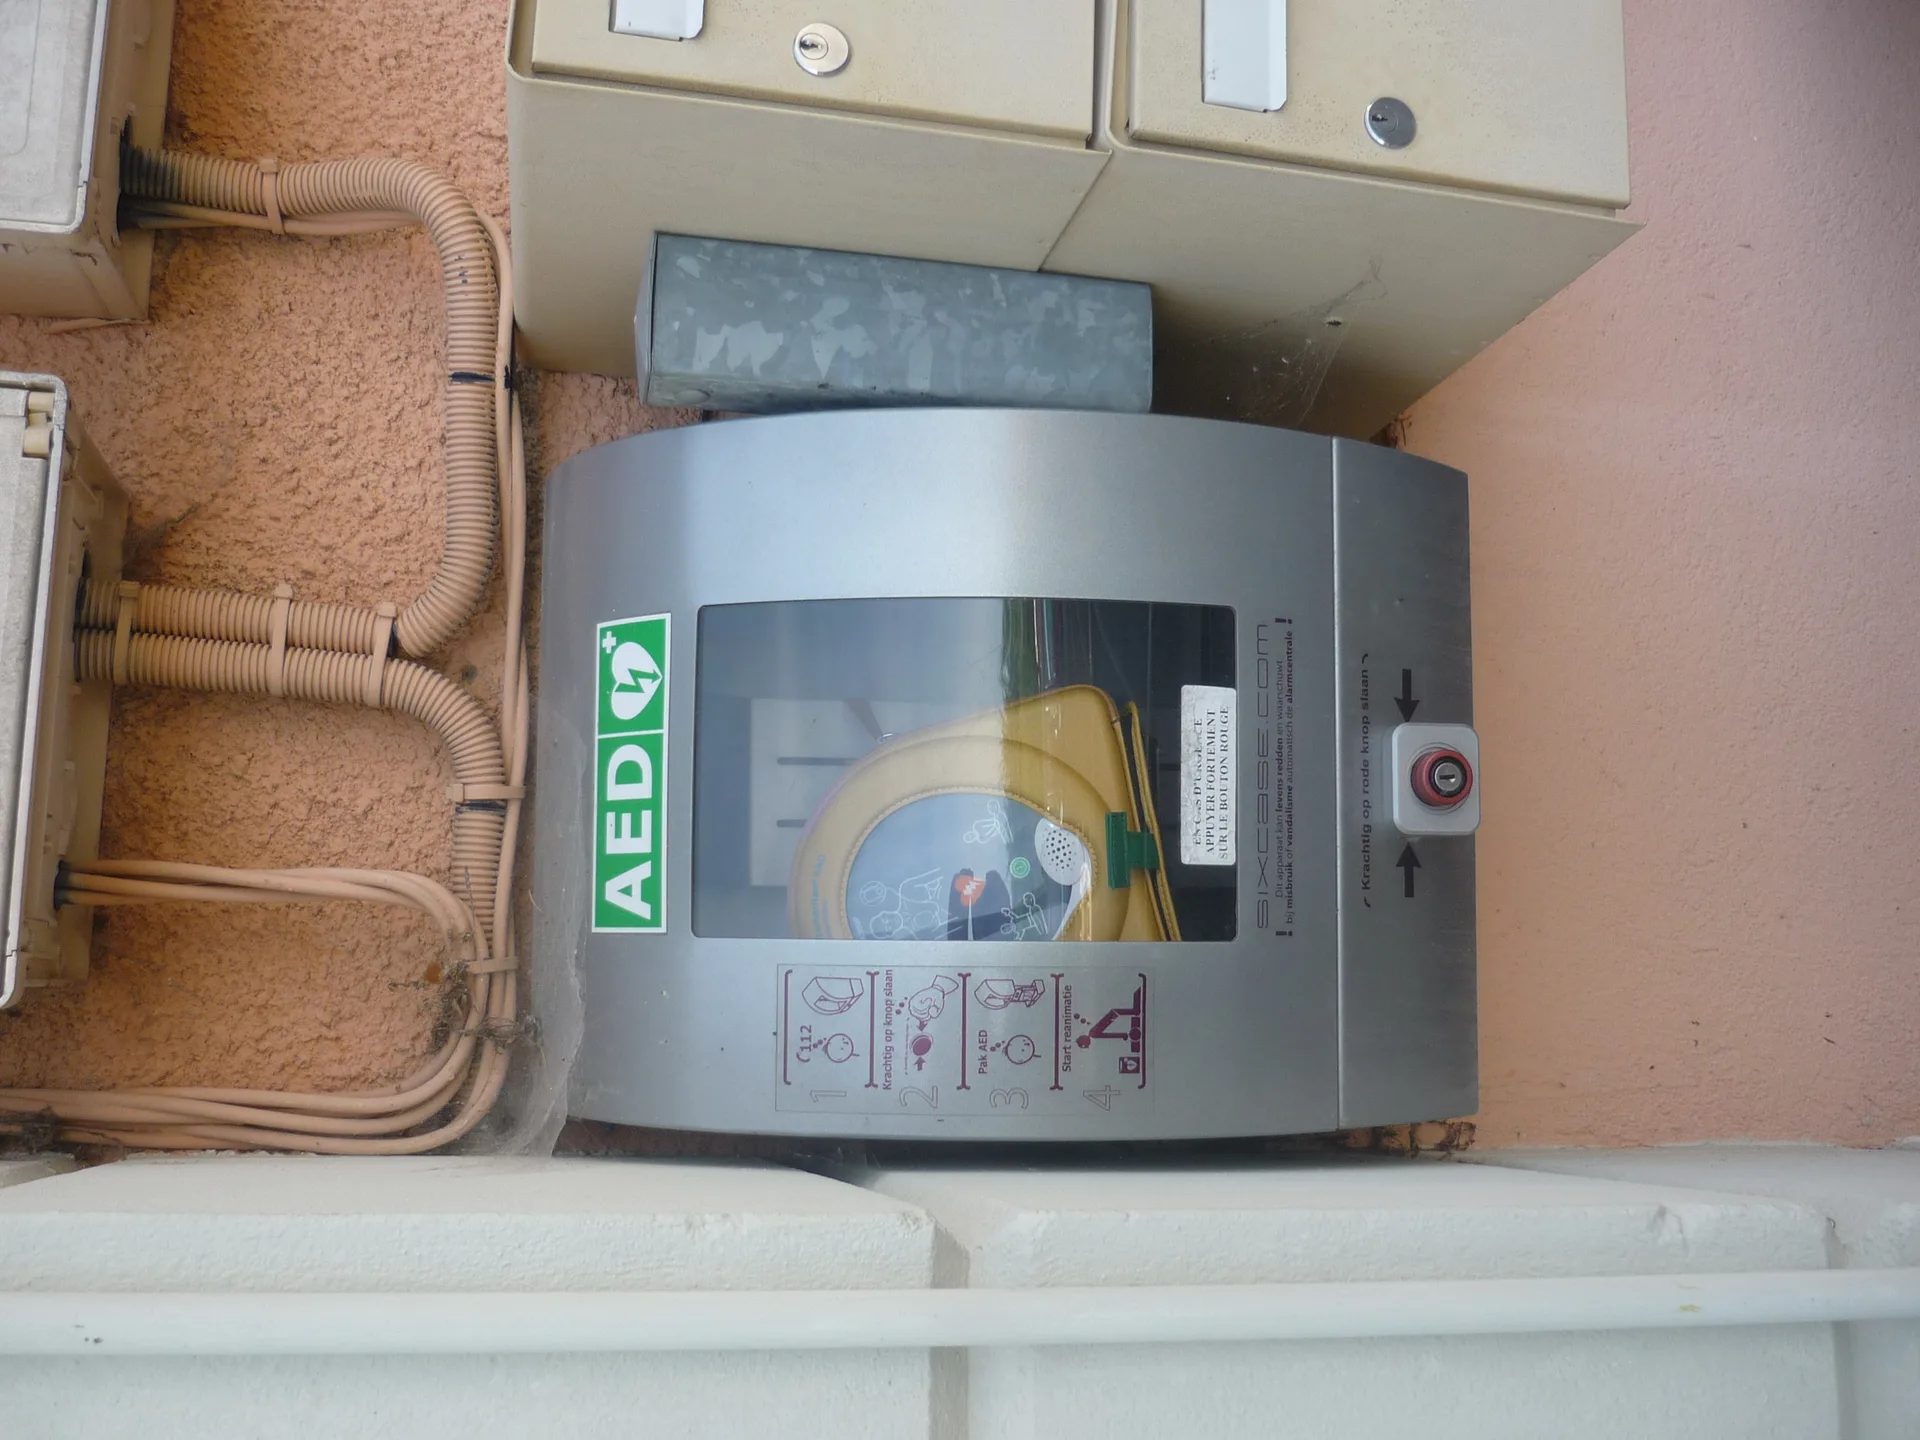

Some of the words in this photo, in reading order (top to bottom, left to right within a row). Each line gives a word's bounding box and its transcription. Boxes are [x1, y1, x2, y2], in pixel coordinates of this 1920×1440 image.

[1285, 631, 1293, 703] alarmcentrale
[1360, 670, 1369, 710] slaan
[1286, 706, 1293, 719] de
[1220, 706, 1228, 752] ROUGE
[1277, 723, 1283, 734] en
[1360, 715, 1370, 753] knop
[1207, 709, 1216, 791] FORTEMENT
[1285, 722, 1293, 783] automatisch
[1220, 756, 1228, 810] BOUTON
[1360, 760, 1369, 794] rode
[1275, 778, 1283, 812] levens
[1220, 814, 1228, 831] LE
[1285, 786, 1293, 846] vandalisme
[1361, 800, 1370, 819] op
[605, 744, 652, 920] AED
[1206, 795, 1215, 854] APPUYER
[1275, 815, 1283, 833] kan
[1220, 835, 1228, 858] SUR
[1276, 836, 1284, 880] apparaat
[1285, 849, 1293, 858] of
[1361, 824, 1371, 890] Krachtig
[1275, 884, 1283, 898] Dit
[1285, 862, 1293, 909] misbruik
[1285, 911, 1294, 924] bij
[884, 970, 893, 996] slaan
[883, 1000, 894, 1025] knop
[1062, 985, 1072, 1042] reanimatie
[800, 1025, 811, 1052] 112
[884, 1029, 894, 1042] op
[978, 1030, 987, 1052] AED
[883, 1046, 894, 1090] Krachtig
[978, 1055, 987, 1074] Pak
[1062, 1046, 1071, 1072] Start
[810, 1090, 846, 1102] 1
[899, 1086, 938, 1108] 2
[989, 1087, 1028, 1109] 3
[1083, 1085, 1119, 1111] 4
